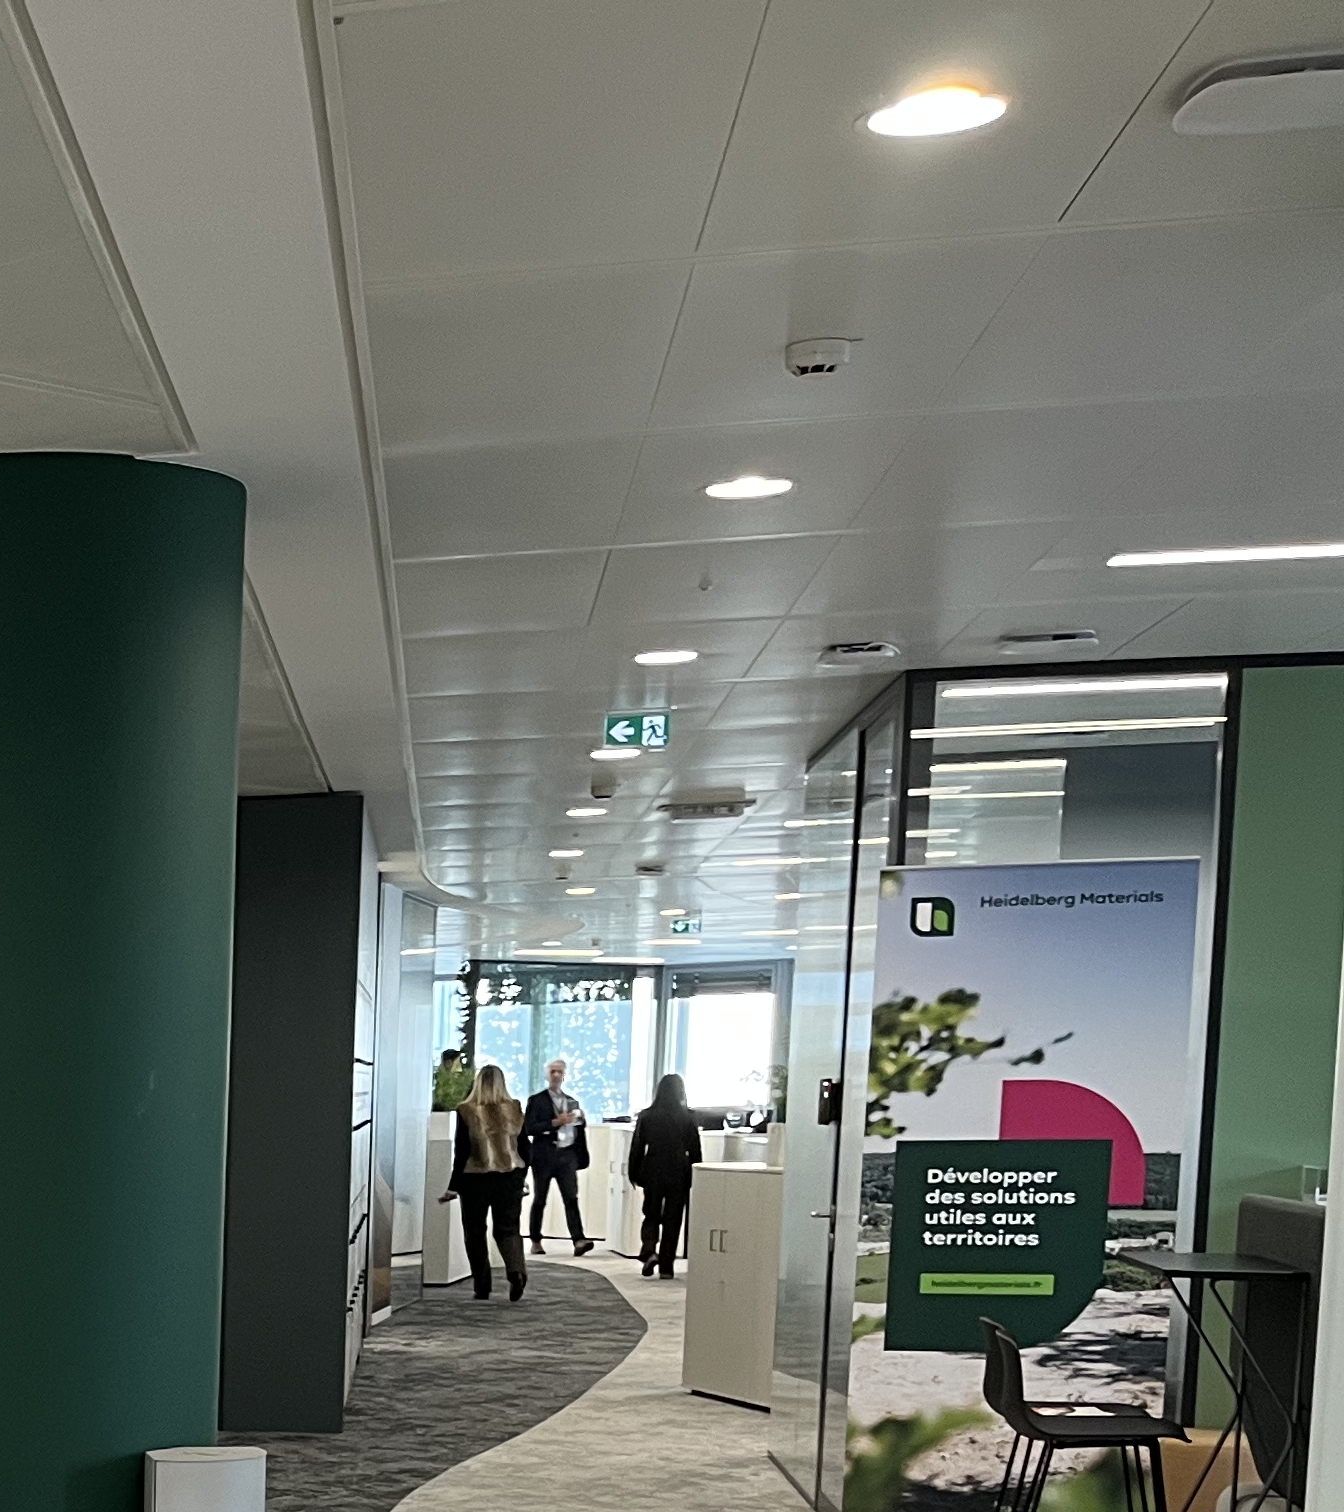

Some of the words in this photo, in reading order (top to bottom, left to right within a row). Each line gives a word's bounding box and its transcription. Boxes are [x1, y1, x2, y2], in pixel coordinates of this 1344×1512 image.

[979, 893, 1076, 908] Heidelberg
[1079, 889, 1164, 904] Materials
[926, 1167, 1058, 1188] Développer
[924, 1188, 966, 1205] des
[970, 1187, 1077, 1205] solutions
[924, 1208, 987, 1225] utiles
[991, 1212, 1037, 1226] aux
[922, 1228, 1040, 1246] territoires
